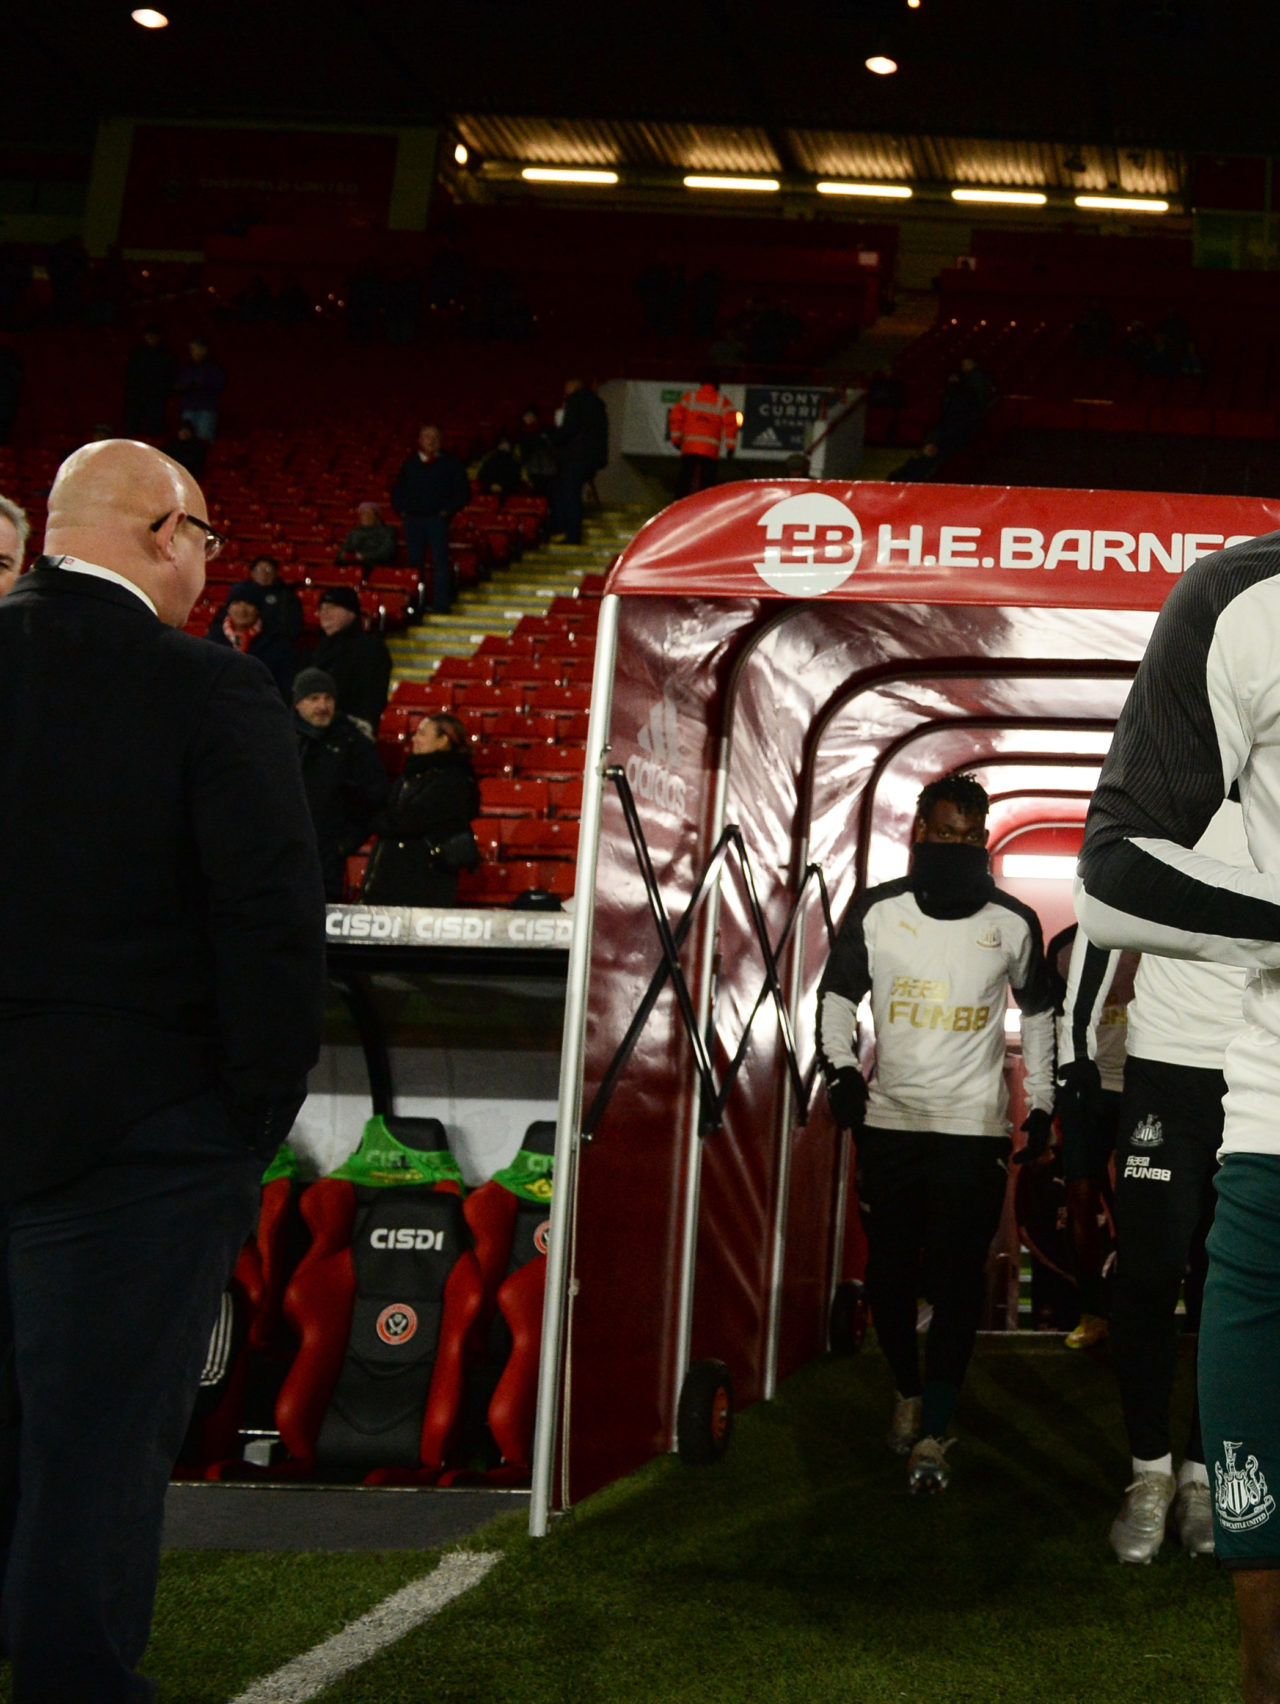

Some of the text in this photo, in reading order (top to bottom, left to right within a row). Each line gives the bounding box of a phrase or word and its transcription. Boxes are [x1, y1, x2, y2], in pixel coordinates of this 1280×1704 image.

[770, 392, 820, 404] TONY
[759, 403, 818, 417] CURRI
[875, 524, 1257, 573] H.E.BARNE
[326, 912, 573, 941] CISDI CISDI CISD
[888, 1000, 990, 1032] FUN88
[1124, 1166, 1171, 1181] FUN88
[370, 1228, 444, 1251] CISDI
